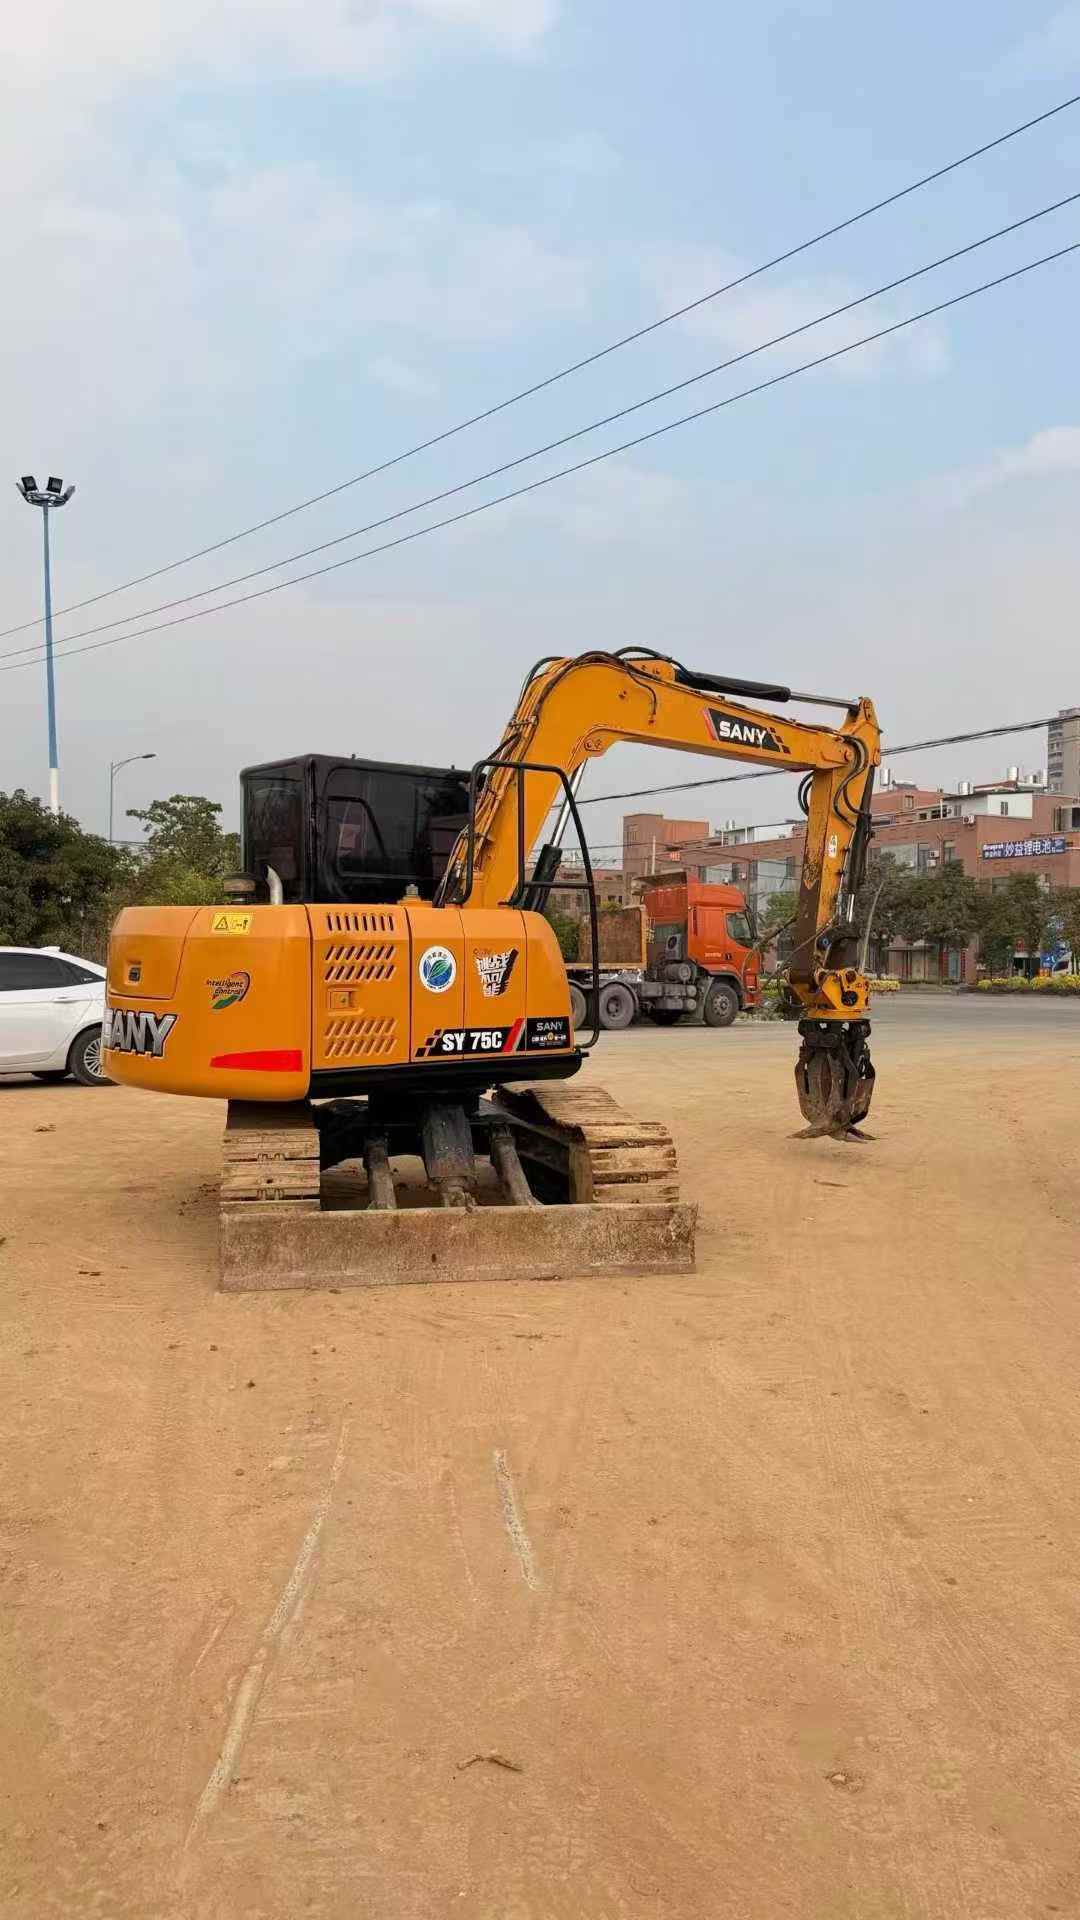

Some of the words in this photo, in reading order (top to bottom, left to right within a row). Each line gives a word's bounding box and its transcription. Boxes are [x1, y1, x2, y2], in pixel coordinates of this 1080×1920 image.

[719, 720, 767, 744] SANY
[536, 1021, 563, 1032] SANY
[442, 1032, 466, 1051] SY
[470, 1031, 503, 1050] 75C
